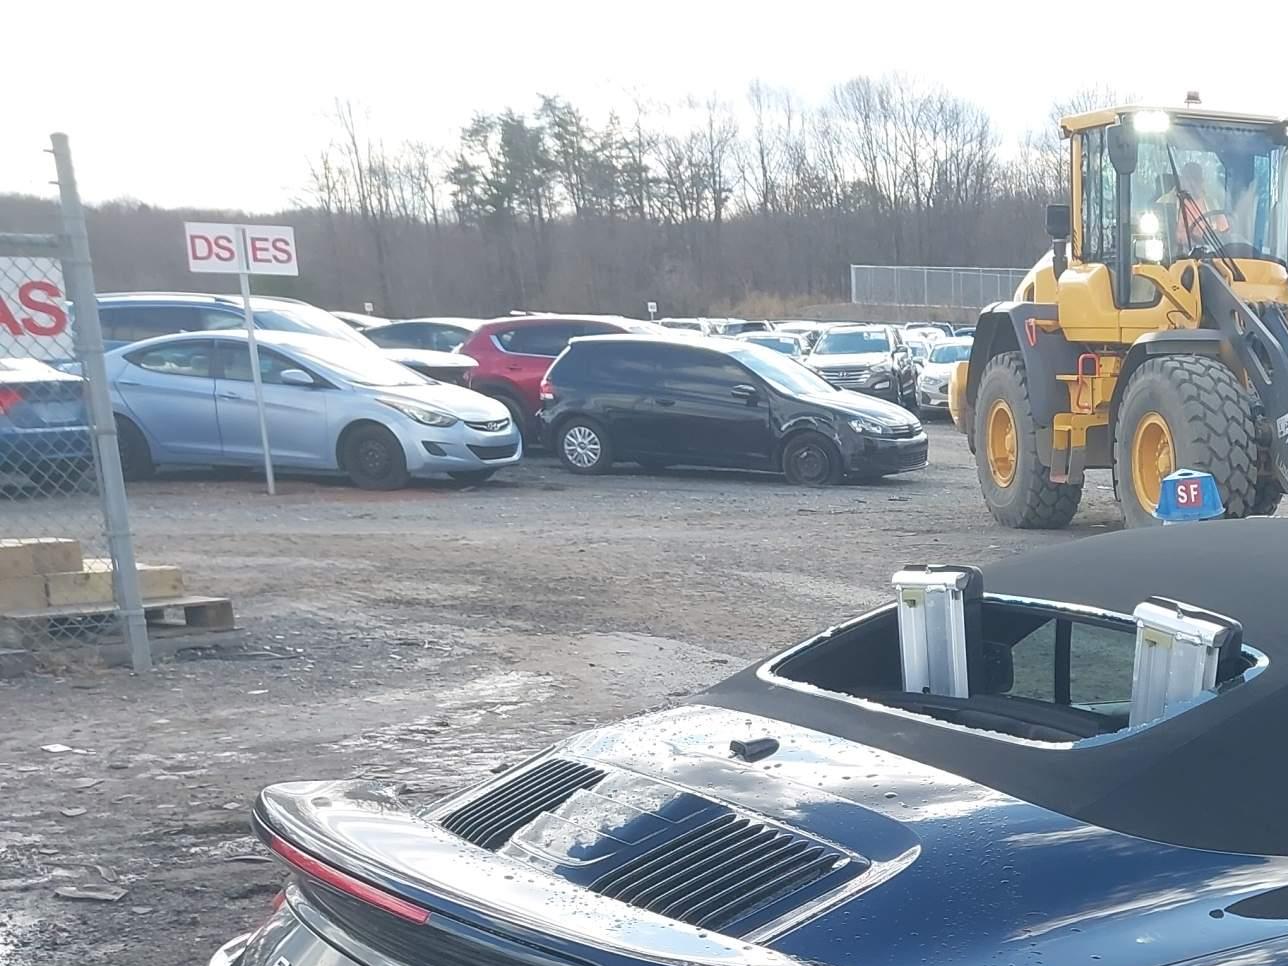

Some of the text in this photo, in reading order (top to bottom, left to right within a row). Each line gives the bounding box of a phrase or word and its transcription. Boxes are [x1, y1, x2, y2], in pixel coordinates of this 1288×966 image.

[189, 234, 236, 262] DS
[250, 236, 293, 264] ES
[1177, 484, 1198, 503] SF
